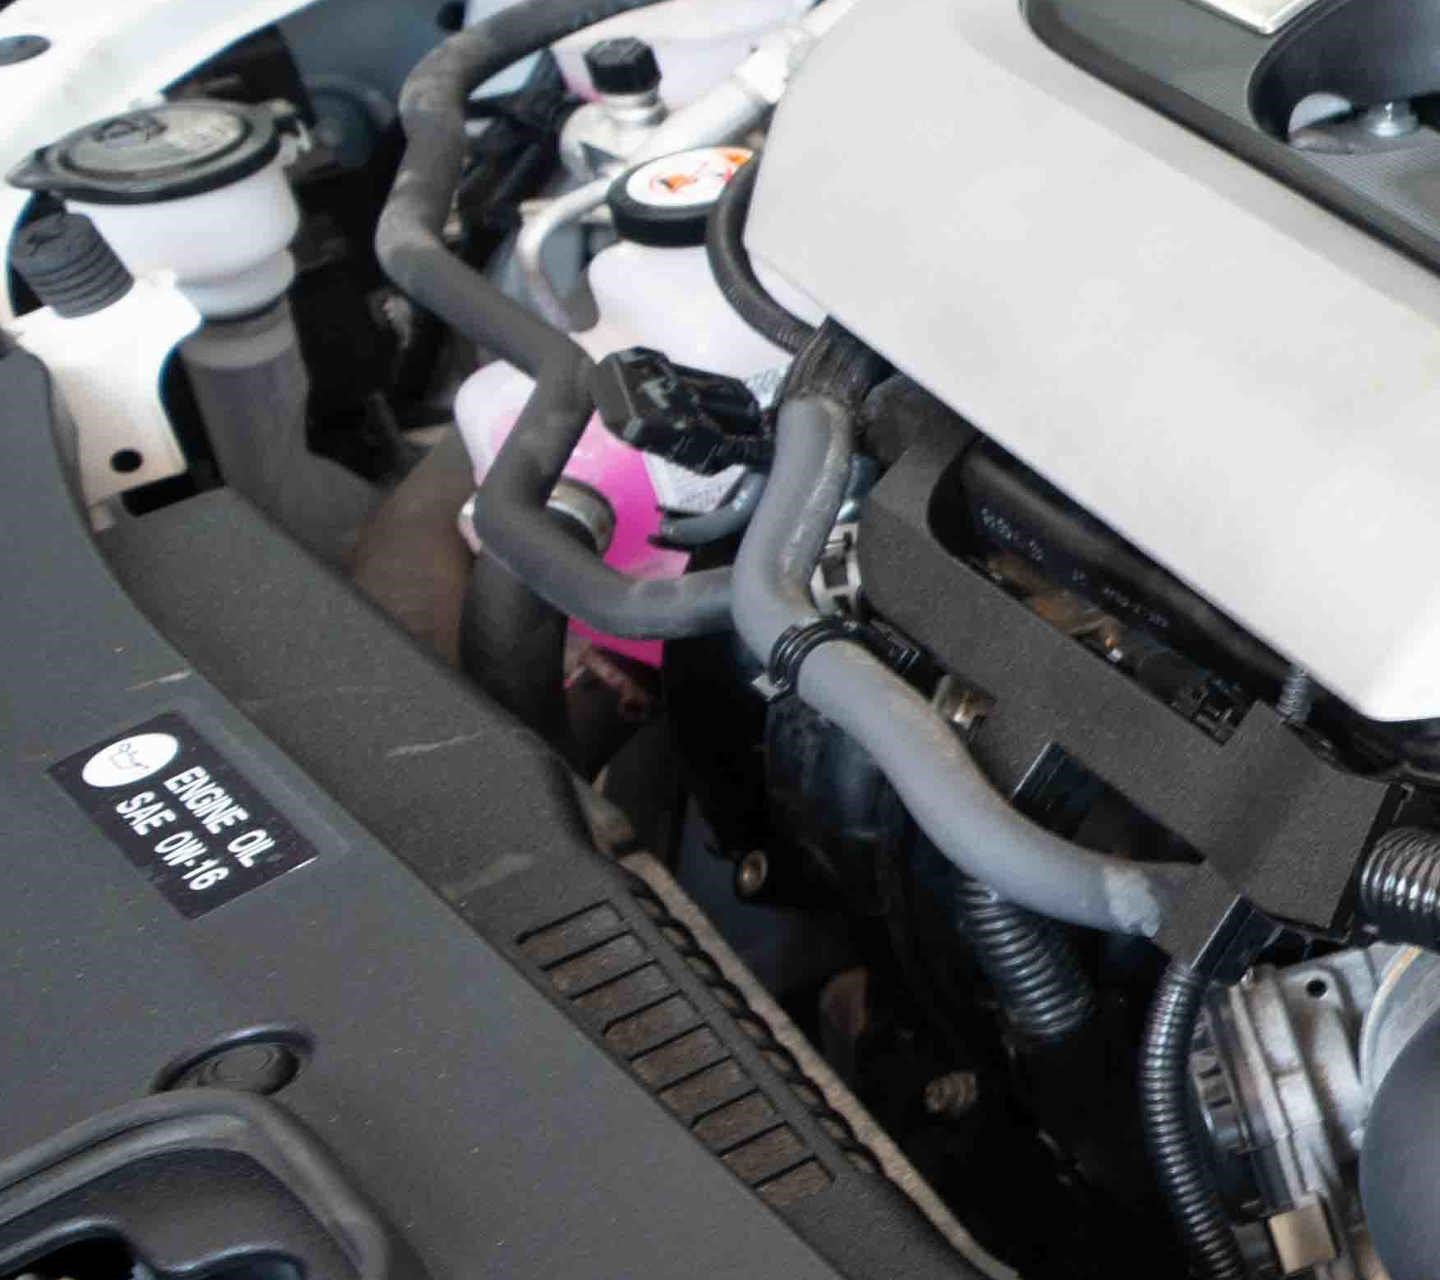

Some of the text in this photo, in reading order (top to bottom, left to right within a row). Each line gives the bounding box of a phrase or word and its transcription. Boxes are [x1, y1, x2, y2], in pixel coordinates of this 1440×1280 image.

[115, 791, 177, 836] SAE
[163, 766, 276, 868] ENGINE OIL
